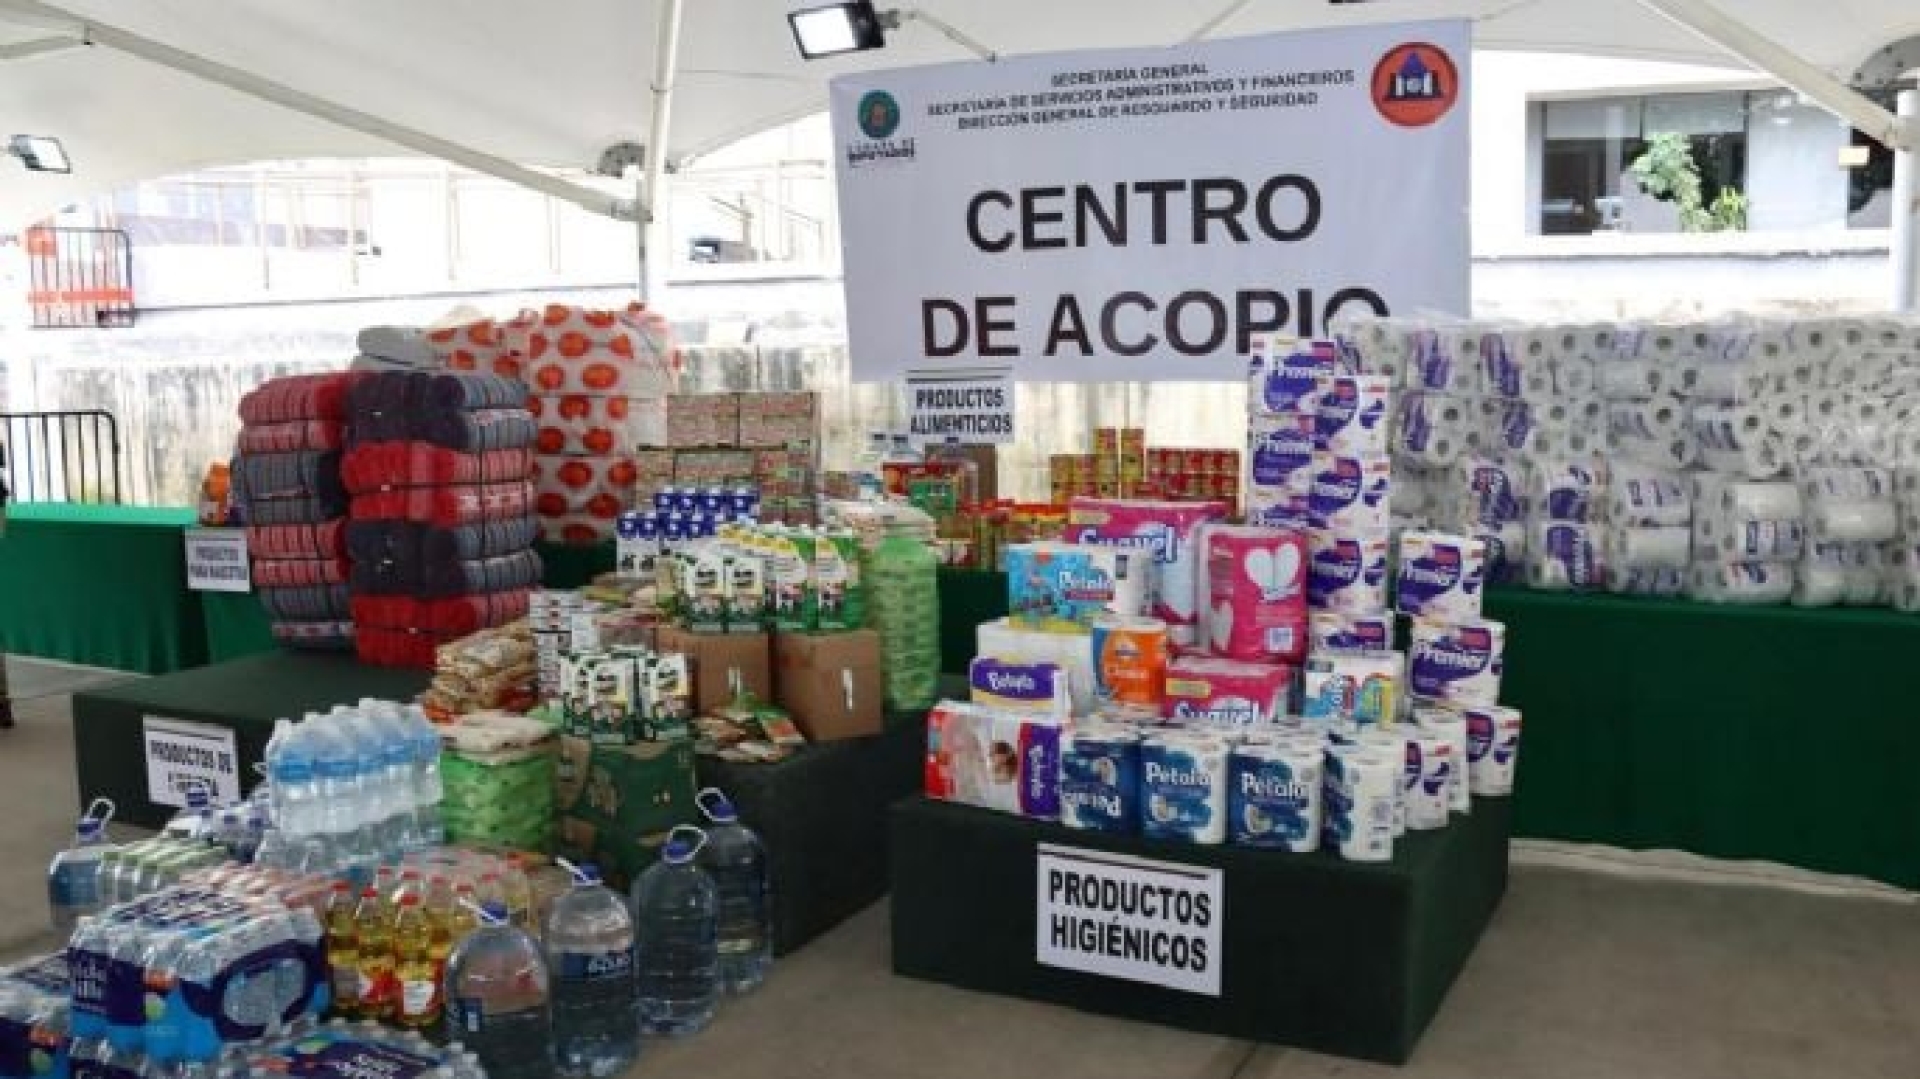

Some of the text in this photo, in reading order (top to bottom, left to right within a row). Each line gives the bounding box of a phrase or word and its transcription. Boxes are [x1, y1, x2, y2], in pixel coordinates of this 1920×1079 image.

[1140, 63, 1208, 81] GENERAL
[1229, 92, 1318, 112] SEGURIDAD
[966, 173, 1322, 254] CENTRO
[921, 295, 1020, 357] DE
[916, 387, 1004, 409] PRODUCTOS
[910, 412, 1013, 434] ALIMENTICIOS
[1048, 868, 1211, 928] PRODUCTOS
[1051, 913, 1207, 974] HIGIÉNICOS
